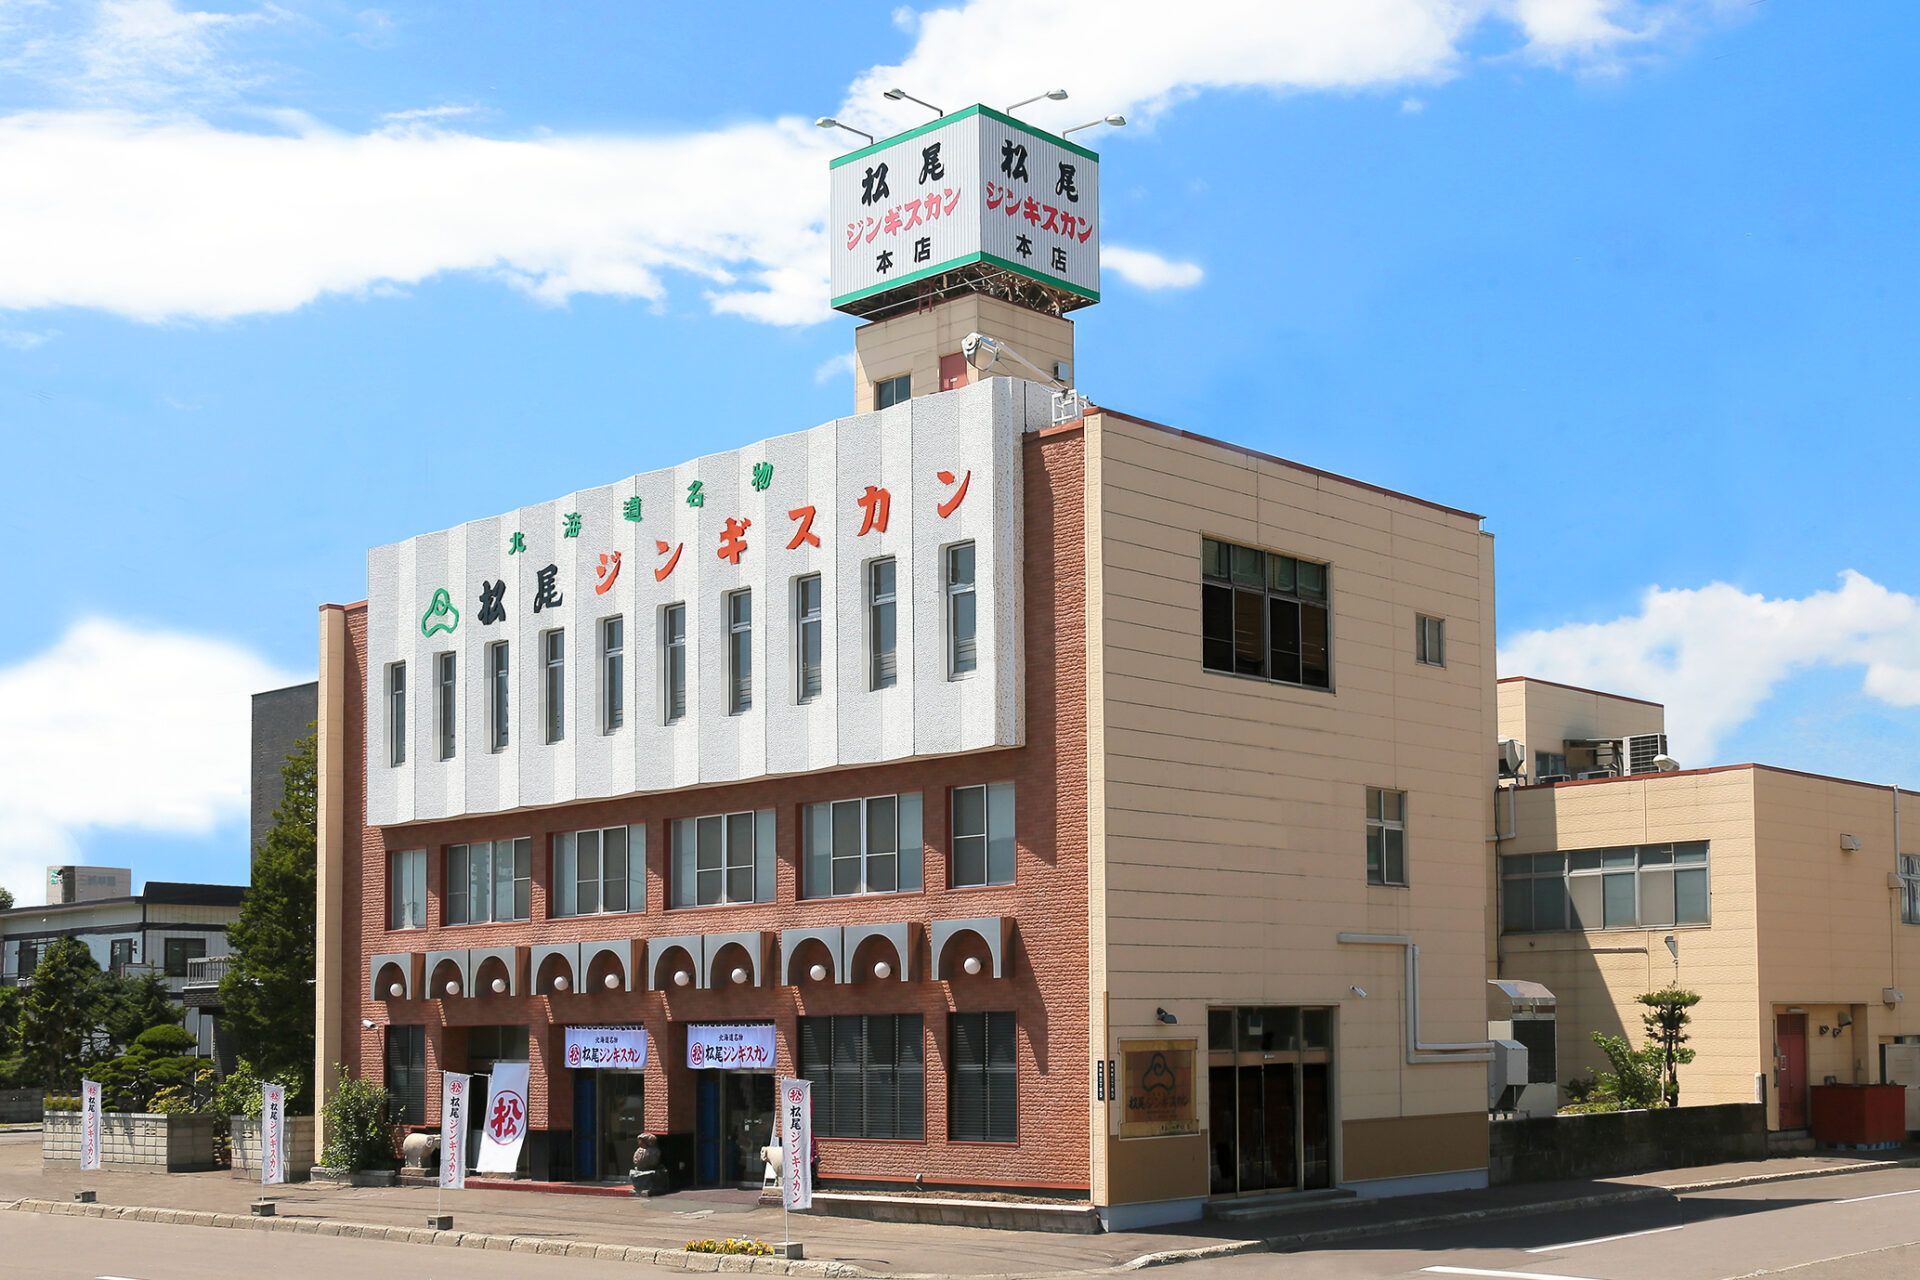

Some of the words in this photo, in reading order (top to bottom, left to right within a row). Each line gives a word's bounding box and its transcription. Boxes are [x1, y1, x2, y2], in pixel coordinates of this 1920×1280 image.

[861, 142, 945, 206] 松尾
[1001, 139, 1079, 202] 松尾
[846, 187, 962, 251] ジンギスカン
[986, 181, 1094, 244] ジンギスカン
[876, 236, 932, 274] 本店
[1015, 233, 1067, 274] 本店
[508, 462, 774, 556] 北海道名物
[477, 469, 972, 627] 松尾ジンギスカン
[569, 1045, 580, 1063] 松
[582, 1046, 640, 1063] 松尾ジンギスカン
[692, 1044, 703, 1063] 松
[705, 1045, 769, 1063] 松尾ジンギスカン
[450, 1082, 462, 1093] 松
[491, 1096, 523, 1138] 松
[790, 1089, 803, 1102] 松
[448, 1096, 460, 1183] 松尾ジンギスカン
[790, 1105, 802, 1204] 松尾ジンギスカン
